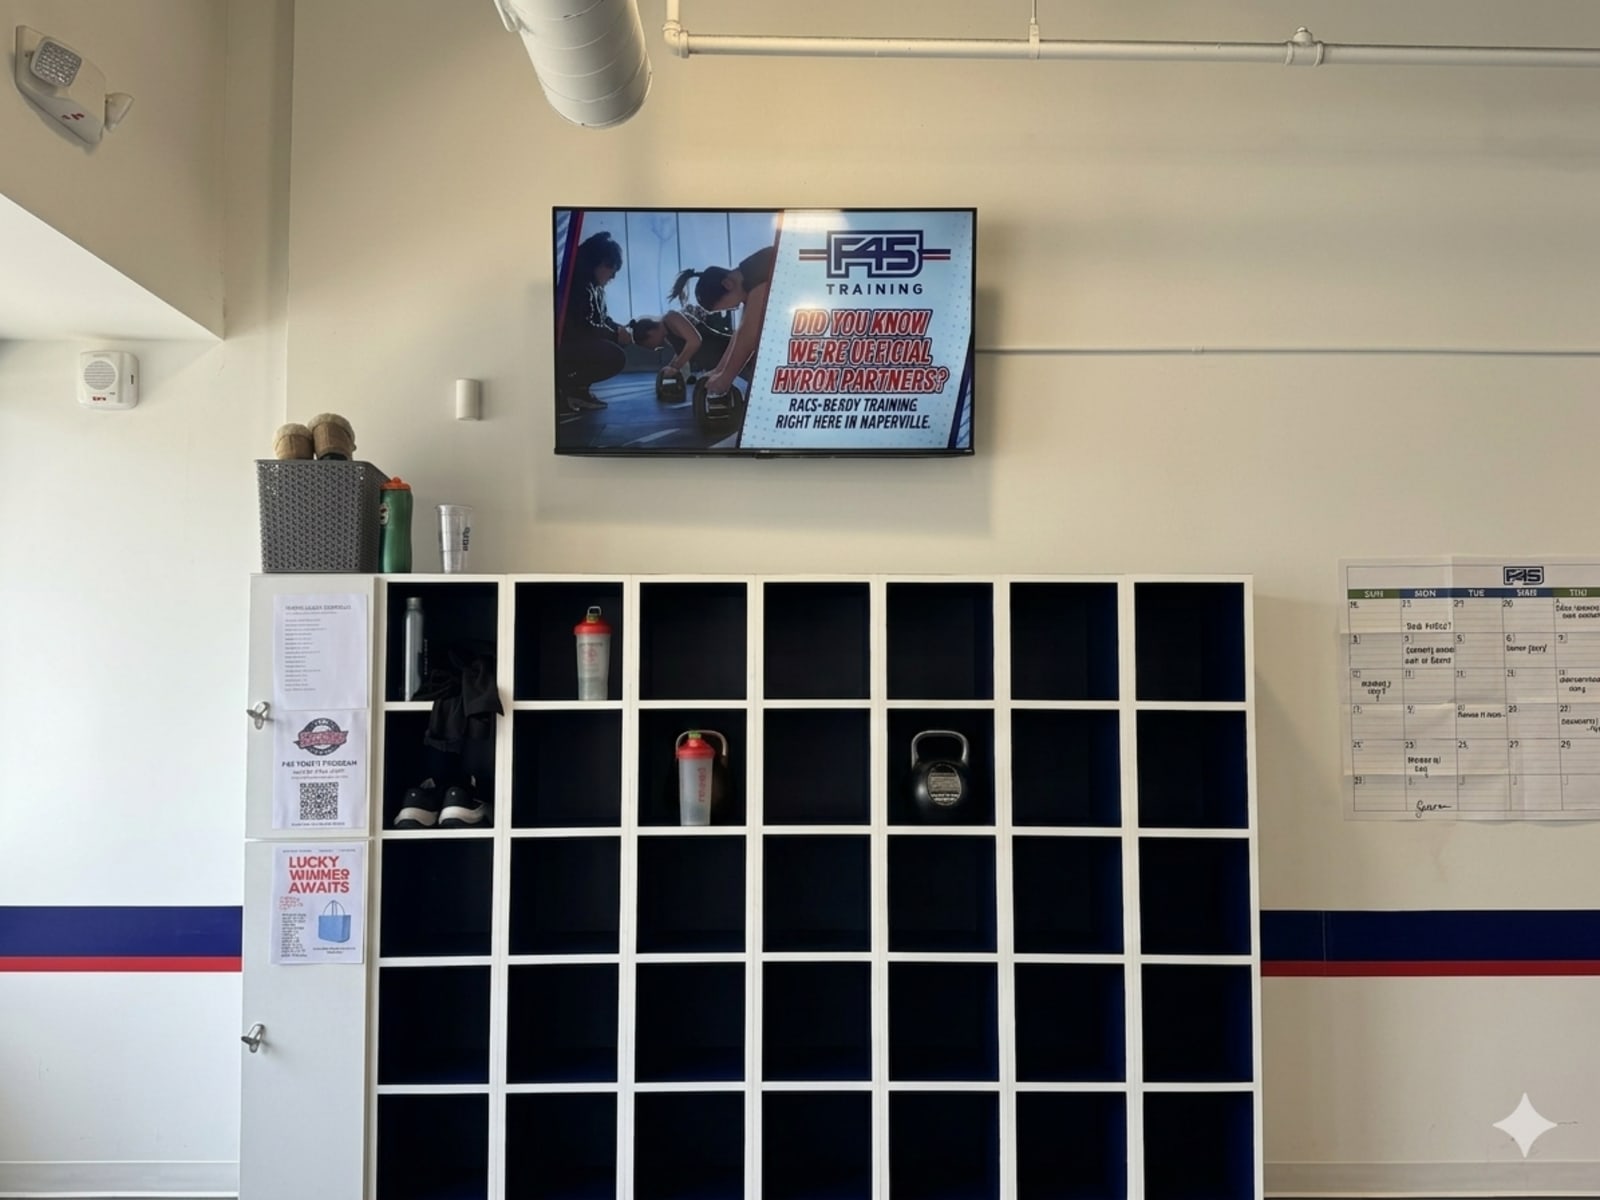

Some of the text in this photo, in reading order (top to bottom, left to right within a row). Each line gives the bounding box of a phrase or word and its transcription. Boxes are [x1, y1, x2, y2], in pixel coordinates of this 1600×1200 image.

[827, 230, 923, 278] F45
[826, 283, 923, 295] TRAINING
[792, 309, 933, 336] DID YOU KNOW
[849, 338, 932, 364] OFFICIAL
[840, 367, 950, 393] PARTNERS?
[864, 398, 918, 412] TRAINING
[776, 415, 931, 429] RIGHT HERE IN NAPERVILLE.
[1468, 589, 1485, 597] TUE
[288, 855, 340, 868] LUCKY
[288, 881, 350, 894] AWAITS
